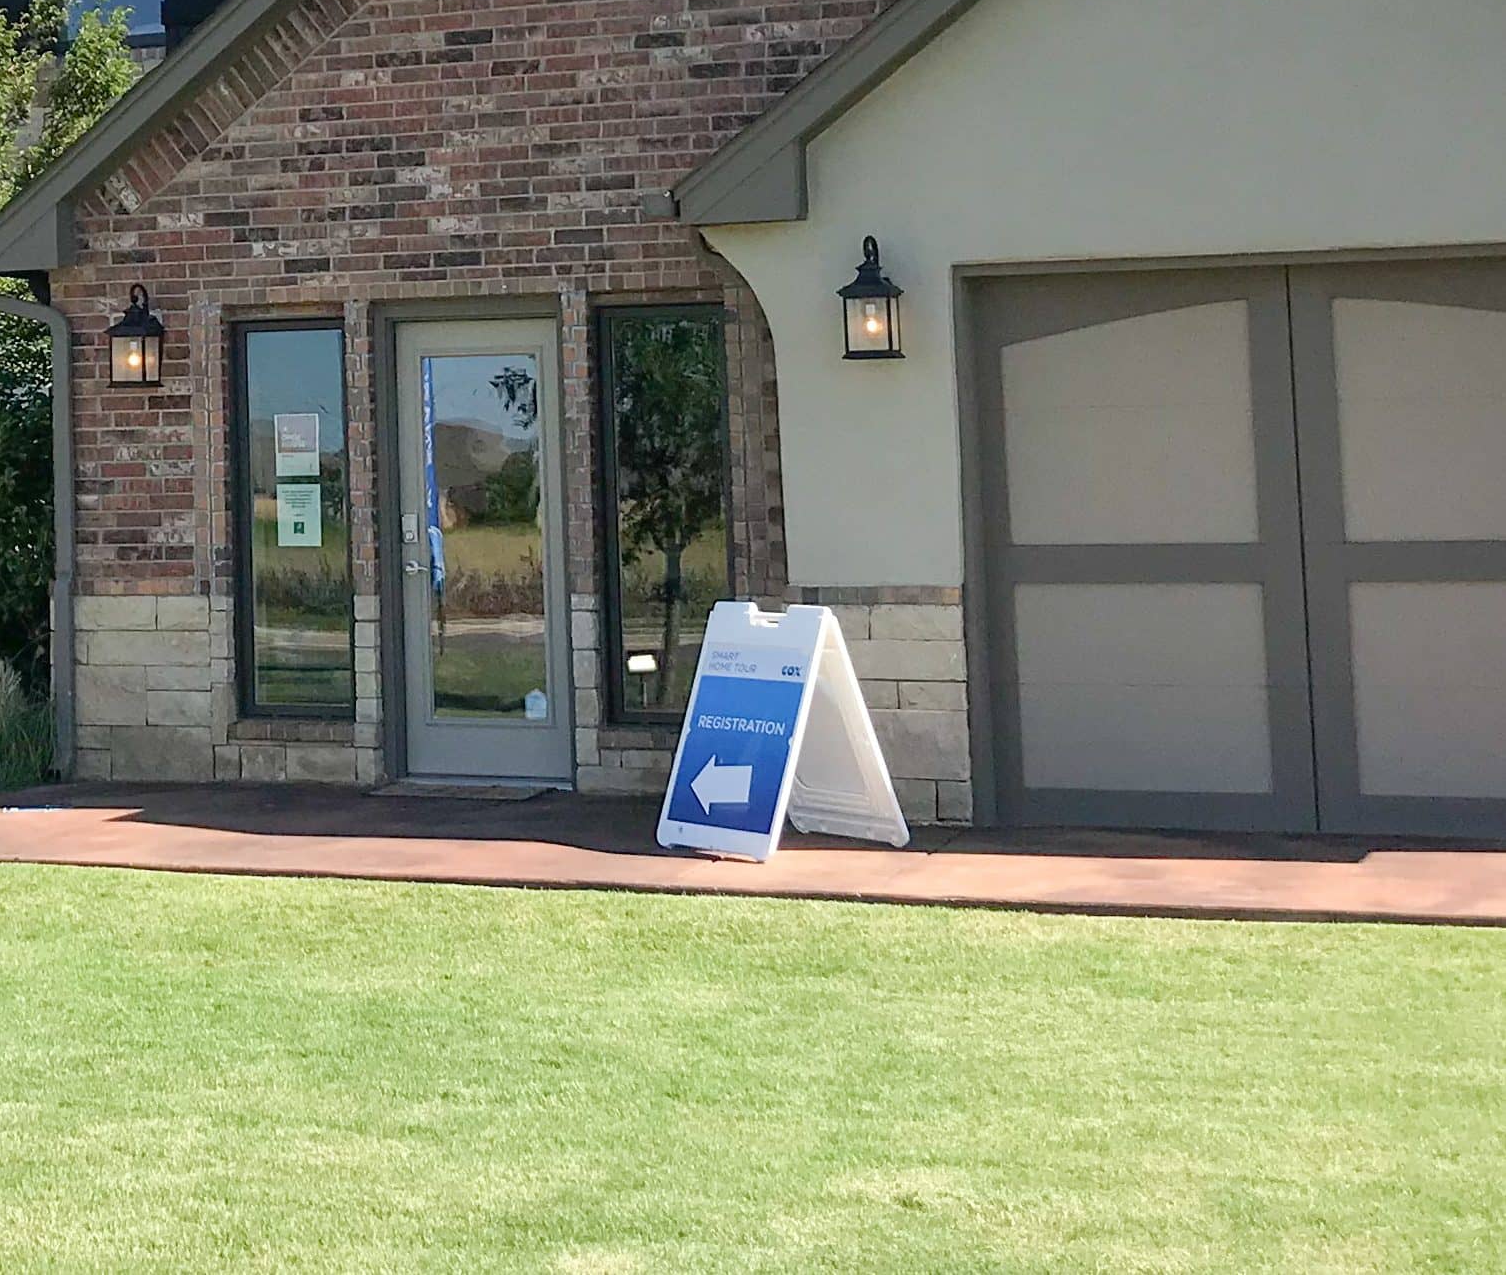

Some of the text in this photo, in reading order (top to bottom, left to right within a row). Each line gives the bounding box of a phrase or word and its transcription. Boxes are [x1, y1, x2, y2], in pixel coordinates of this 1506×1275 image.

[711, 651, 740, 661] SMART
[709, 662, 757, 673] HOME TOUR
[781, 665, 802, 676] COX
[698, 715, 785, 735] REGISTRATION
